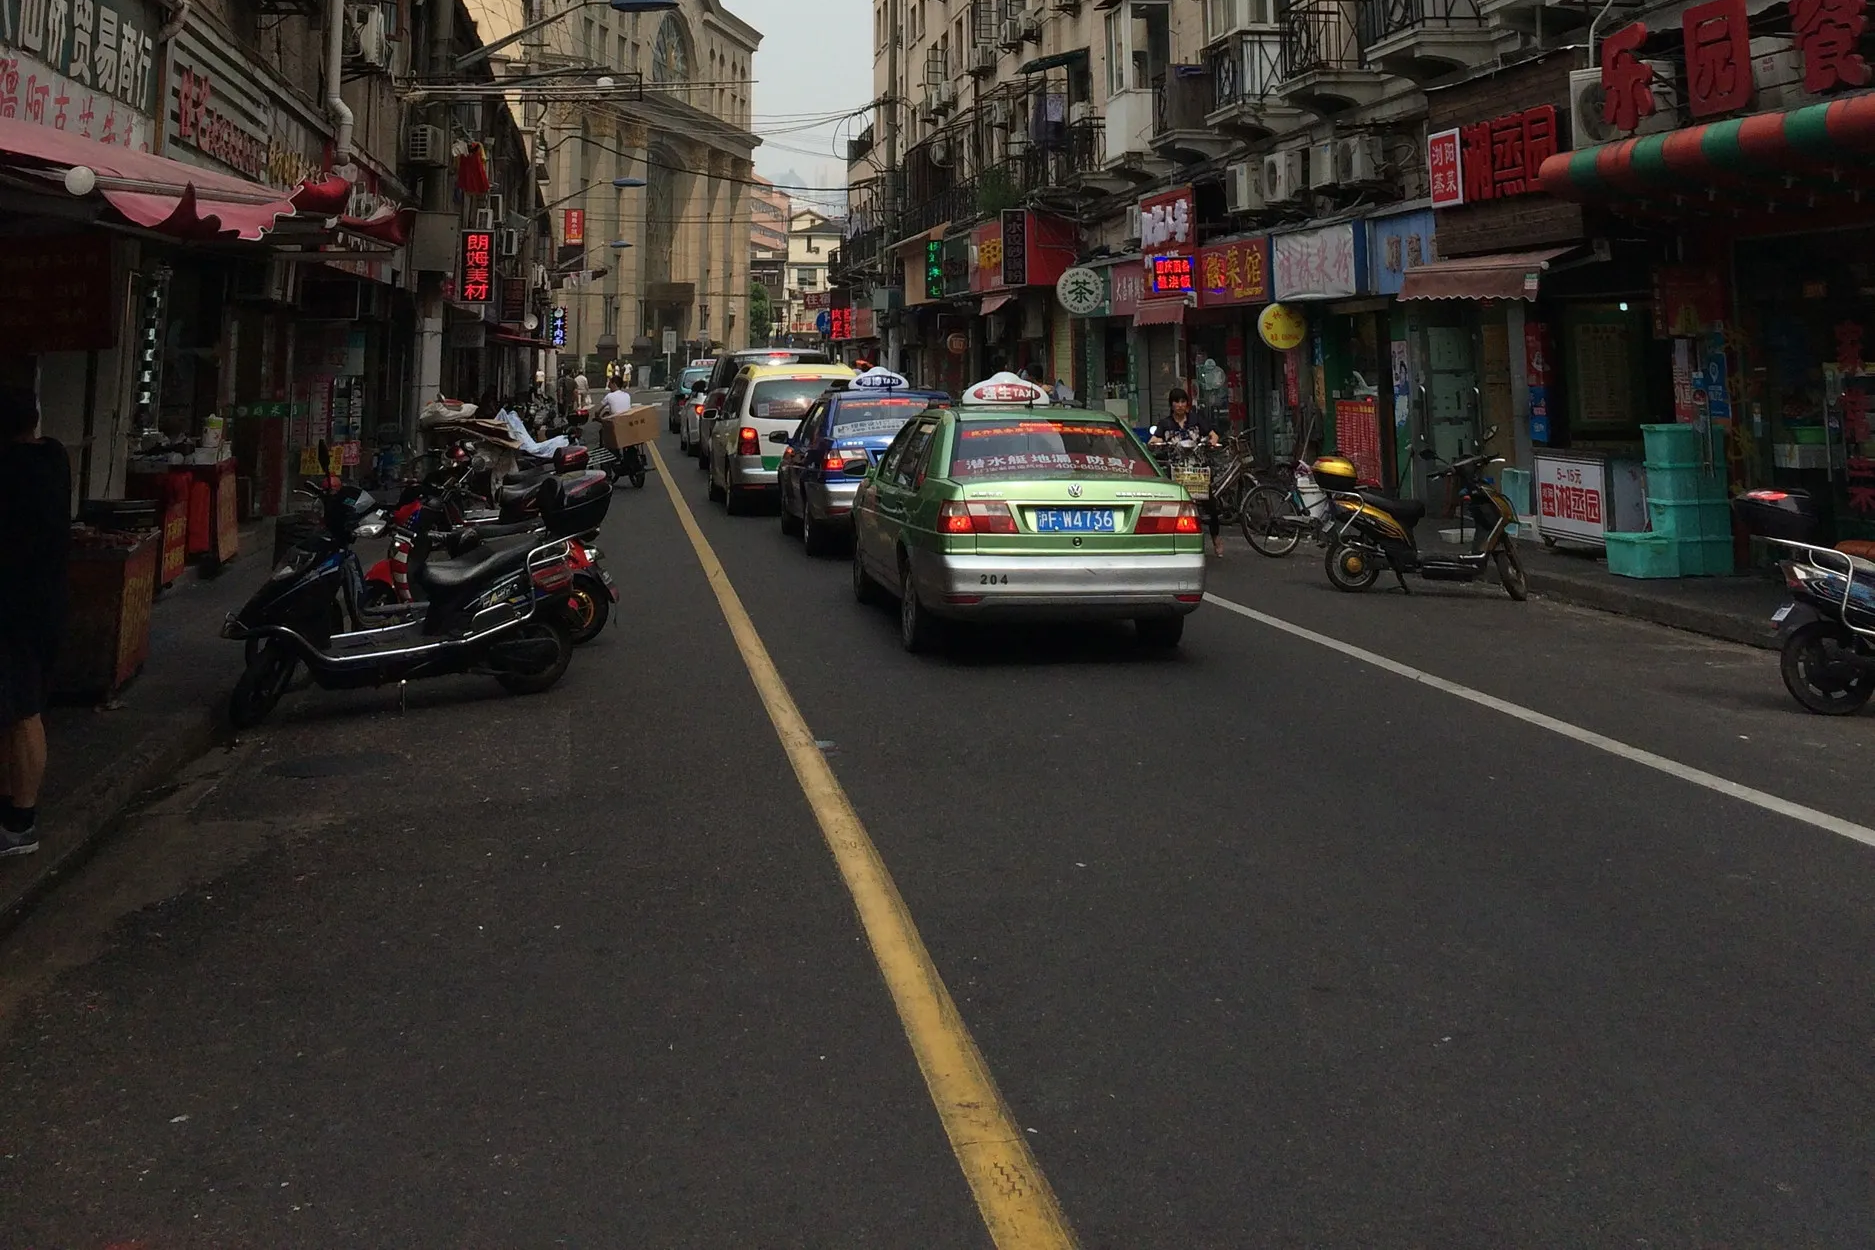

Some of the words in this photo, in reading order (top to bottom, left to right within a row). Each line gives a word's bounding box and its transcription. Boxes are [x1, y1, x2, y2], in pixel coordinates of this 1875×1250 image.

[1432, 142, 1456, 166] 浏阳
[1434, 170, 1457, 194] 蒸菜
[464, 234, 490, 300] 朗姆美材
[1068, 279, 1095, 303] 茶
[982, 385, 1013, 400] 强生
[1013, 389, 1036, 400] TAXI
[1556, 484, 1602, 524] 湘蒸园
[980, 574, 1009, 585] 204
